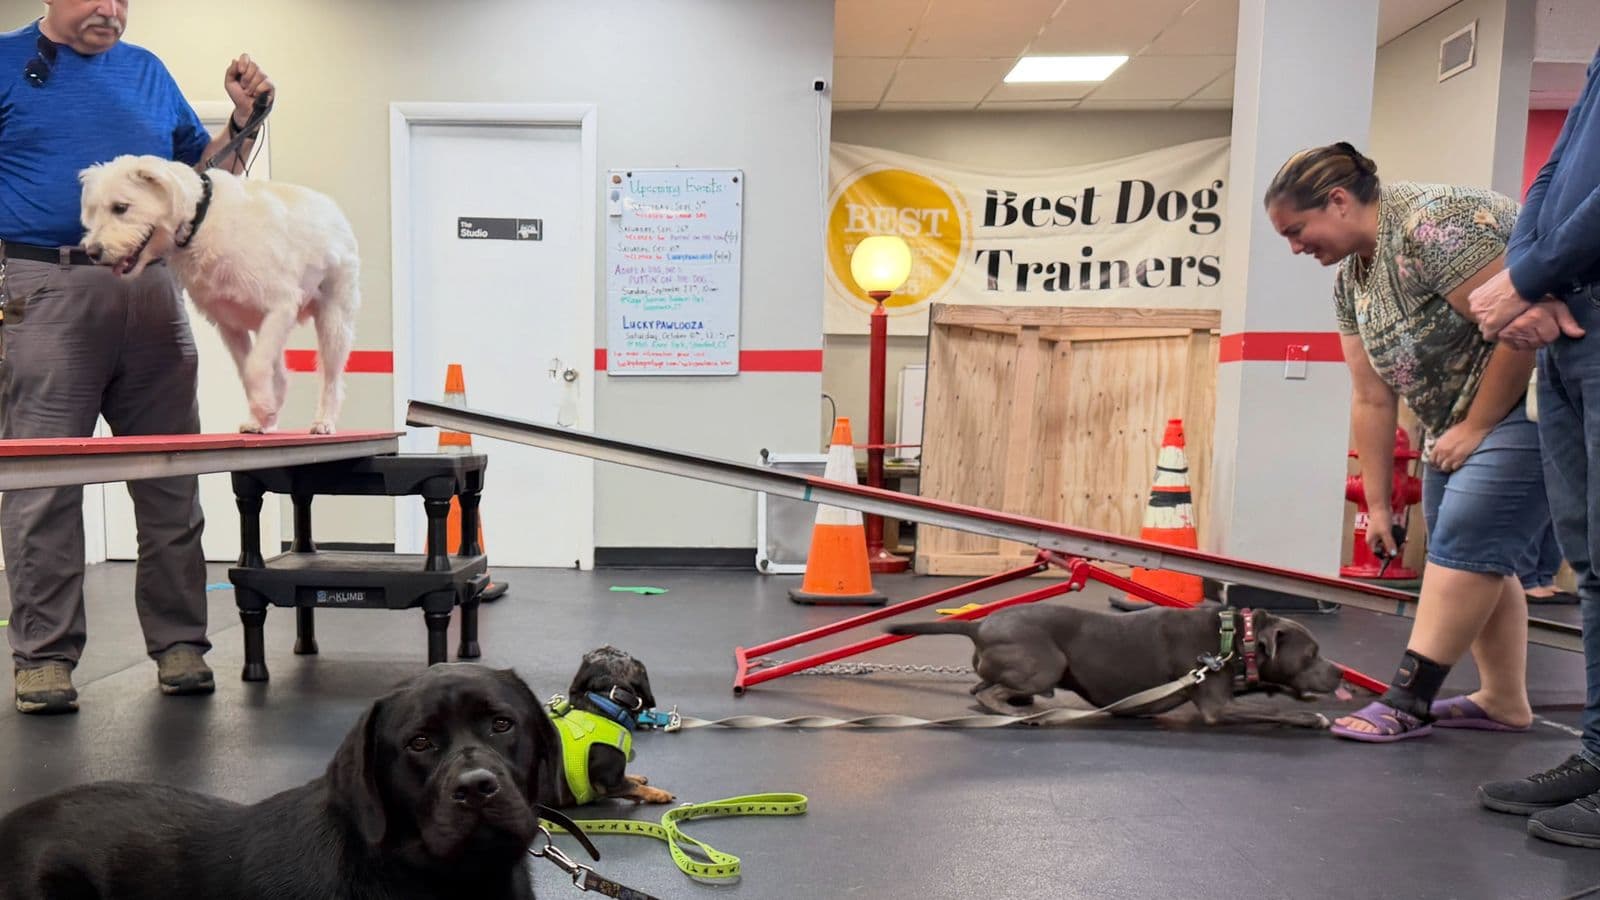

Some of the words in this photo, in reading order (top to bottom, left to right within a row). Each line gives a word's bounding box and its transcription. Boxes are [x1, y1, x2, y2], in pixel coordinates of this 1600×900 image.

[630, 180, 681, 198] Upcoming
[686, 177, 727, 194] Events:
[844, 203, 949, 238] BEST
[979, 186, 1102, 228] Best
[1111, 179, 1224, 236] Dog
[460, 228, 489, 238] Studio
[974, 246, 1222, 293] Trainers
